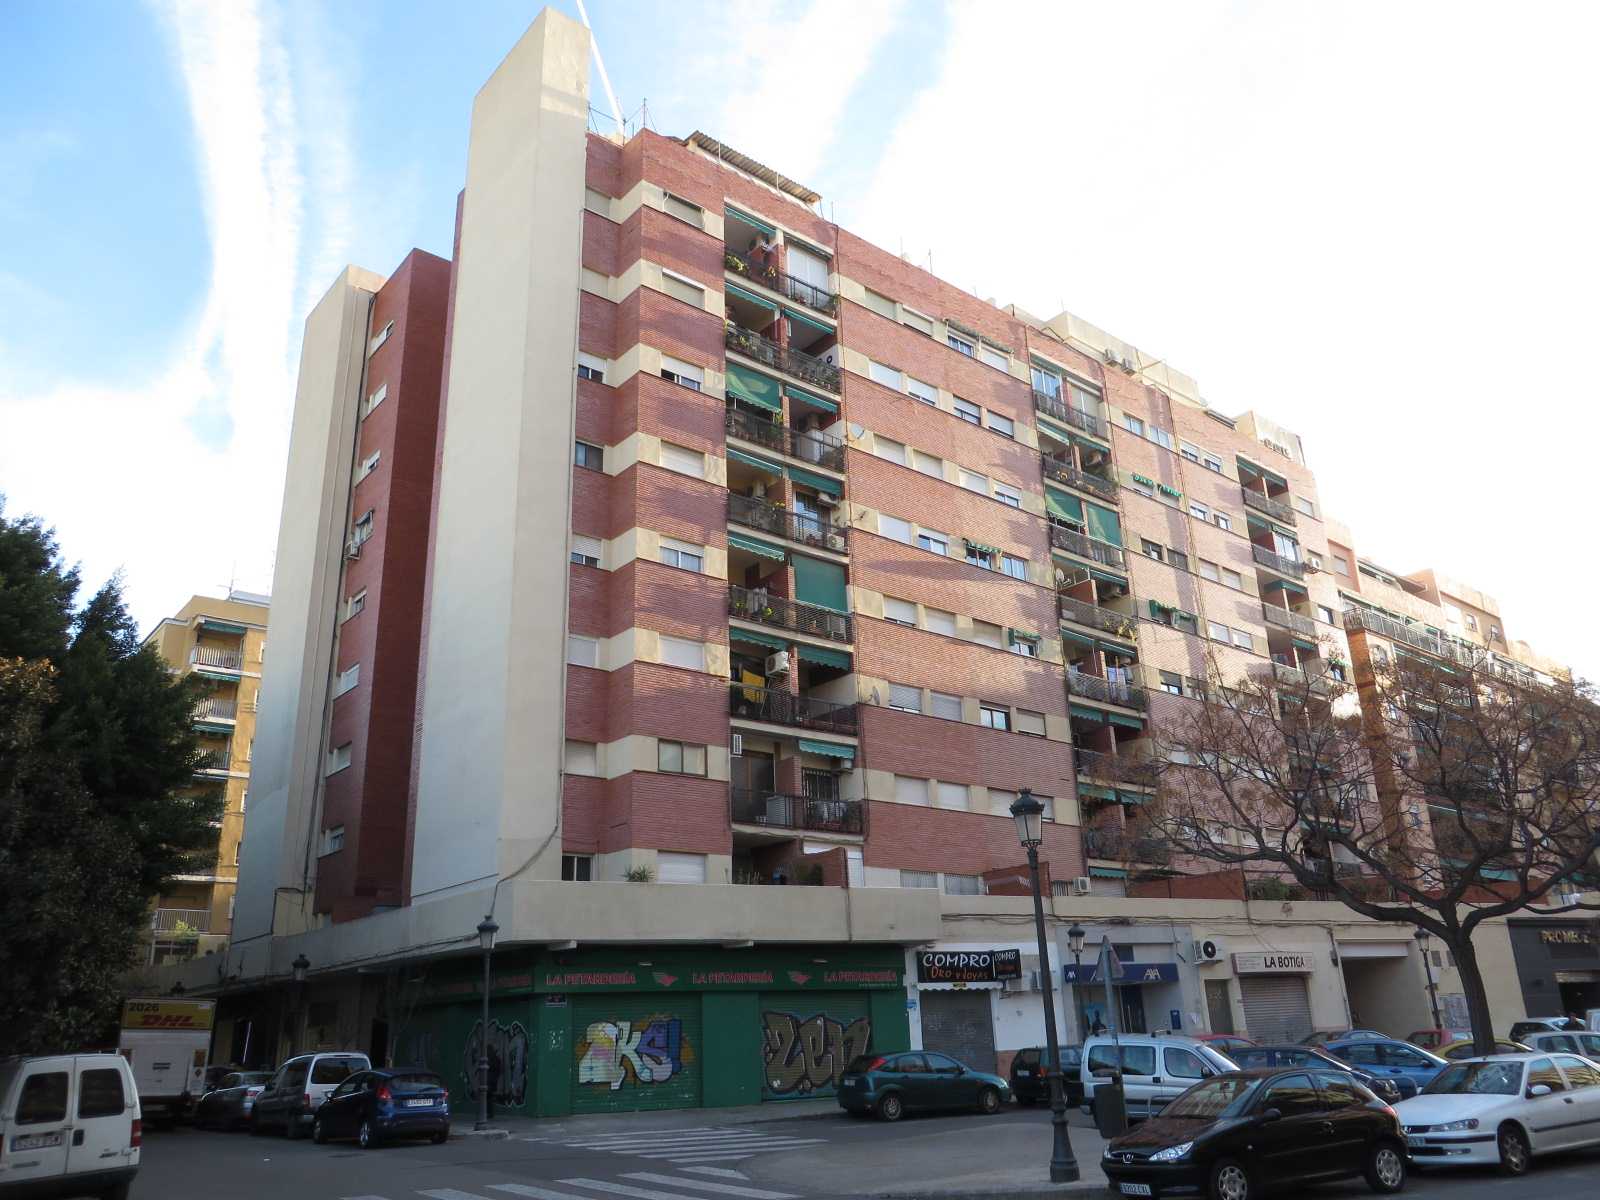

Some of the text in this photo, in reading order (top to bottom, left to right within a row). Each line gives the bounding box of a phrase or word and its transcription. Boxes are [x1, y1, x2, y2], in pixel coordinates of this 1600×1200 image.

[922, 953, 990, 968] COMPRO
[994, 951, 1016, 961] COMPRO
[1264, 956, 1276, 968] LA
[1278, 956, 1305, 968] BOTIGA
[545, 973, 561, 985] LA
[1143, 968, 1161, 980] AXA
[142, 1014, 193, 1026] DHL
